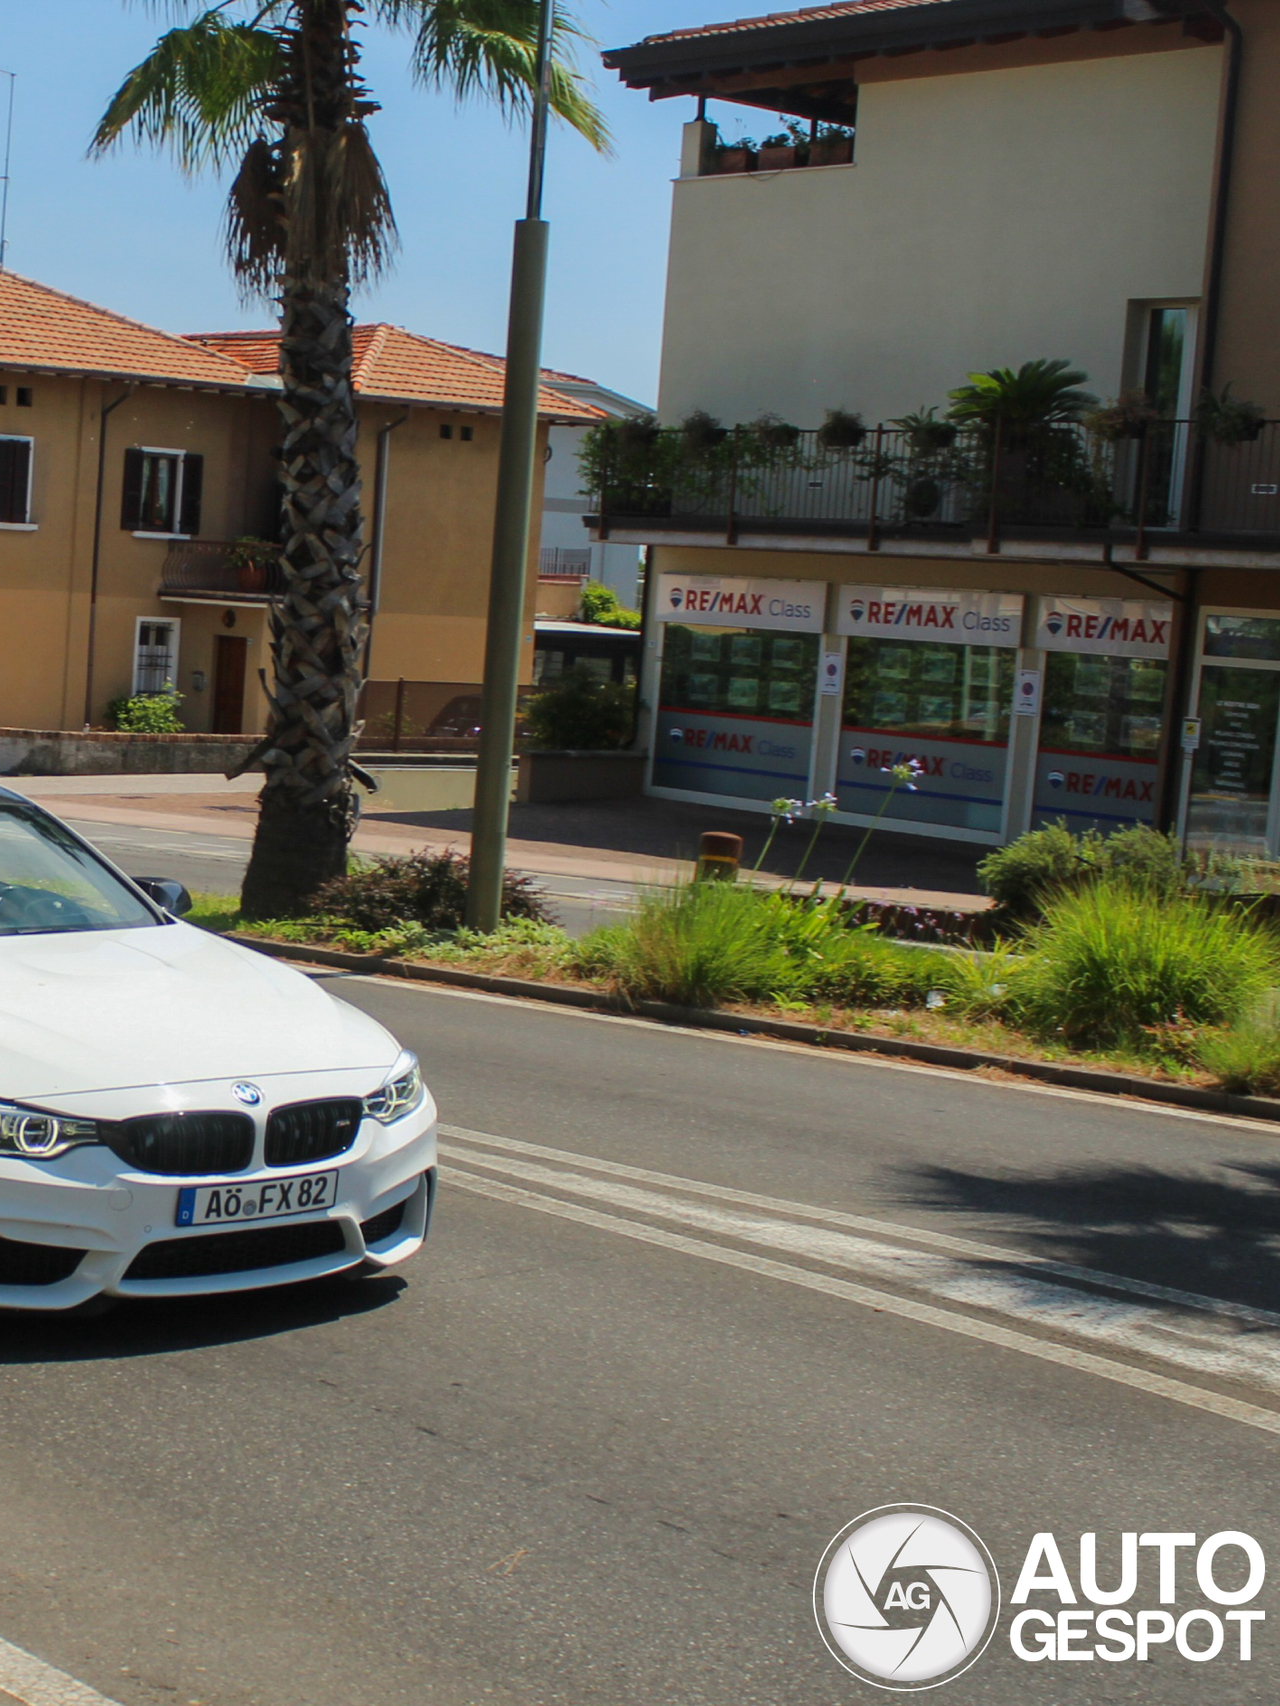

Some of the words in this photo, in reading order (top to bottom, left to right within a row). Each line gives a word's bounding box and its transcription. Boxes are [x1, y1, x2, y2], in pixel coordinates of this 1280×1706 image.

[685, 588, 762, 616] RE/MAX
[769, 597, 812, 619] Class
[868, 600, 955, 629] RE/MAX
[962, 610, 1011, 632] Class
[1066, 614, 1165, 645] RE/MAX
[684, 726, 752, 754] RE/MAX
[757, 738, 797, 759] Class
[950, 762, 993, 783] Class
[1066, 771, 1153, 802] RE/MAX
[182, 1210, 189, 1219] D
[205, 1188, 241, 1219] AÖ
